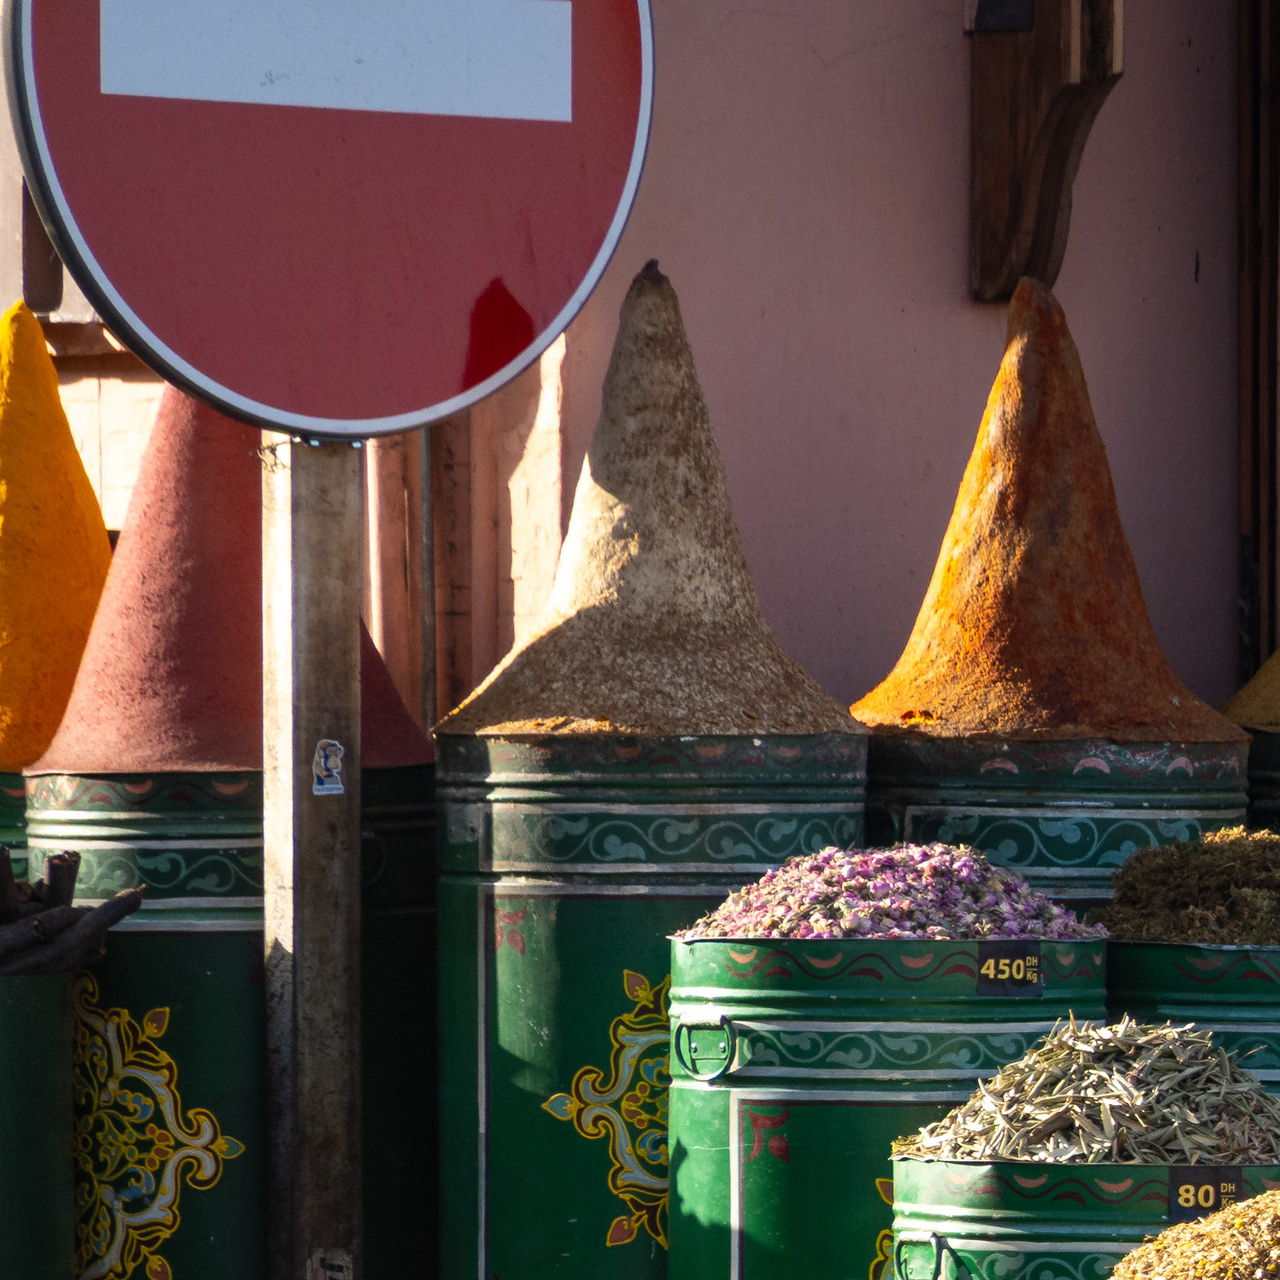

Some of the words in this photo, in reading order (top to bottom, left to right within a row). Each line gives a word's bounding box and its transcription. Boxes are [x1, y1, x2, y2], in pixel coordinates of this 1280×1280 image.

[1025, 956, 1039, 967] DH
[980, 958, 1025, 980] 450
[1026, 970, 1038, 984] Kg
[1220, 1182, 1236, 1193] DH
[1177, 1184, 1216, 1209] 80
